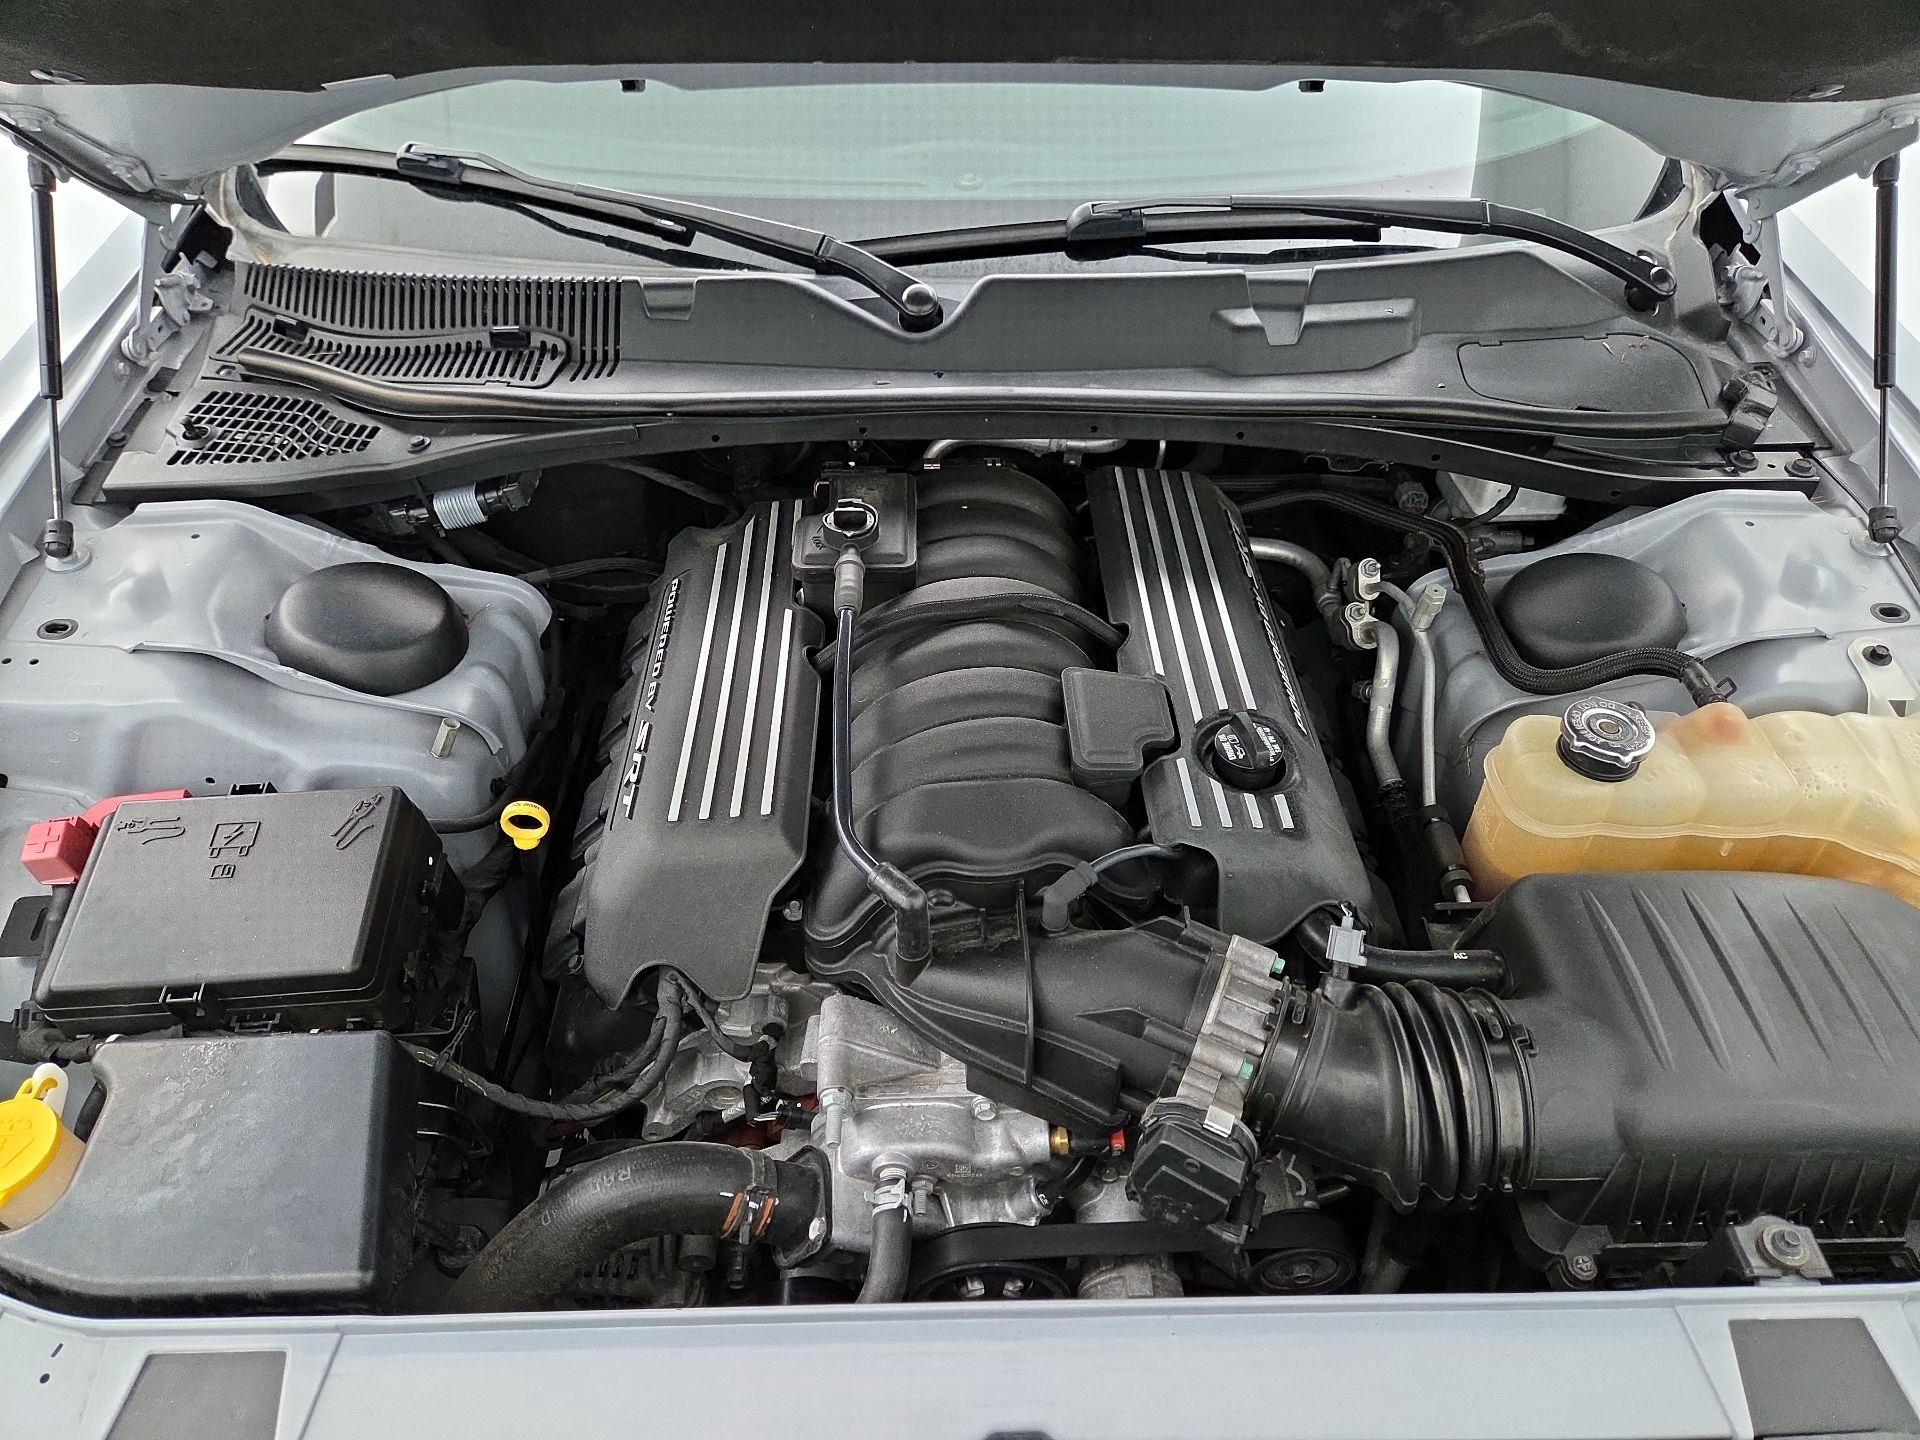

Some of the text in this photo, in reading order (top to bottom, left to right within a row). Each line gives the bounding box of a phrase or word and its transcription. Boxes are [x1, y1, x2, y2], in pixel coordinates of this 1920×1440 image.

[622, 578, 679, 818] POWERED BY SRT
[1453, 952, 1468, 960] AC
